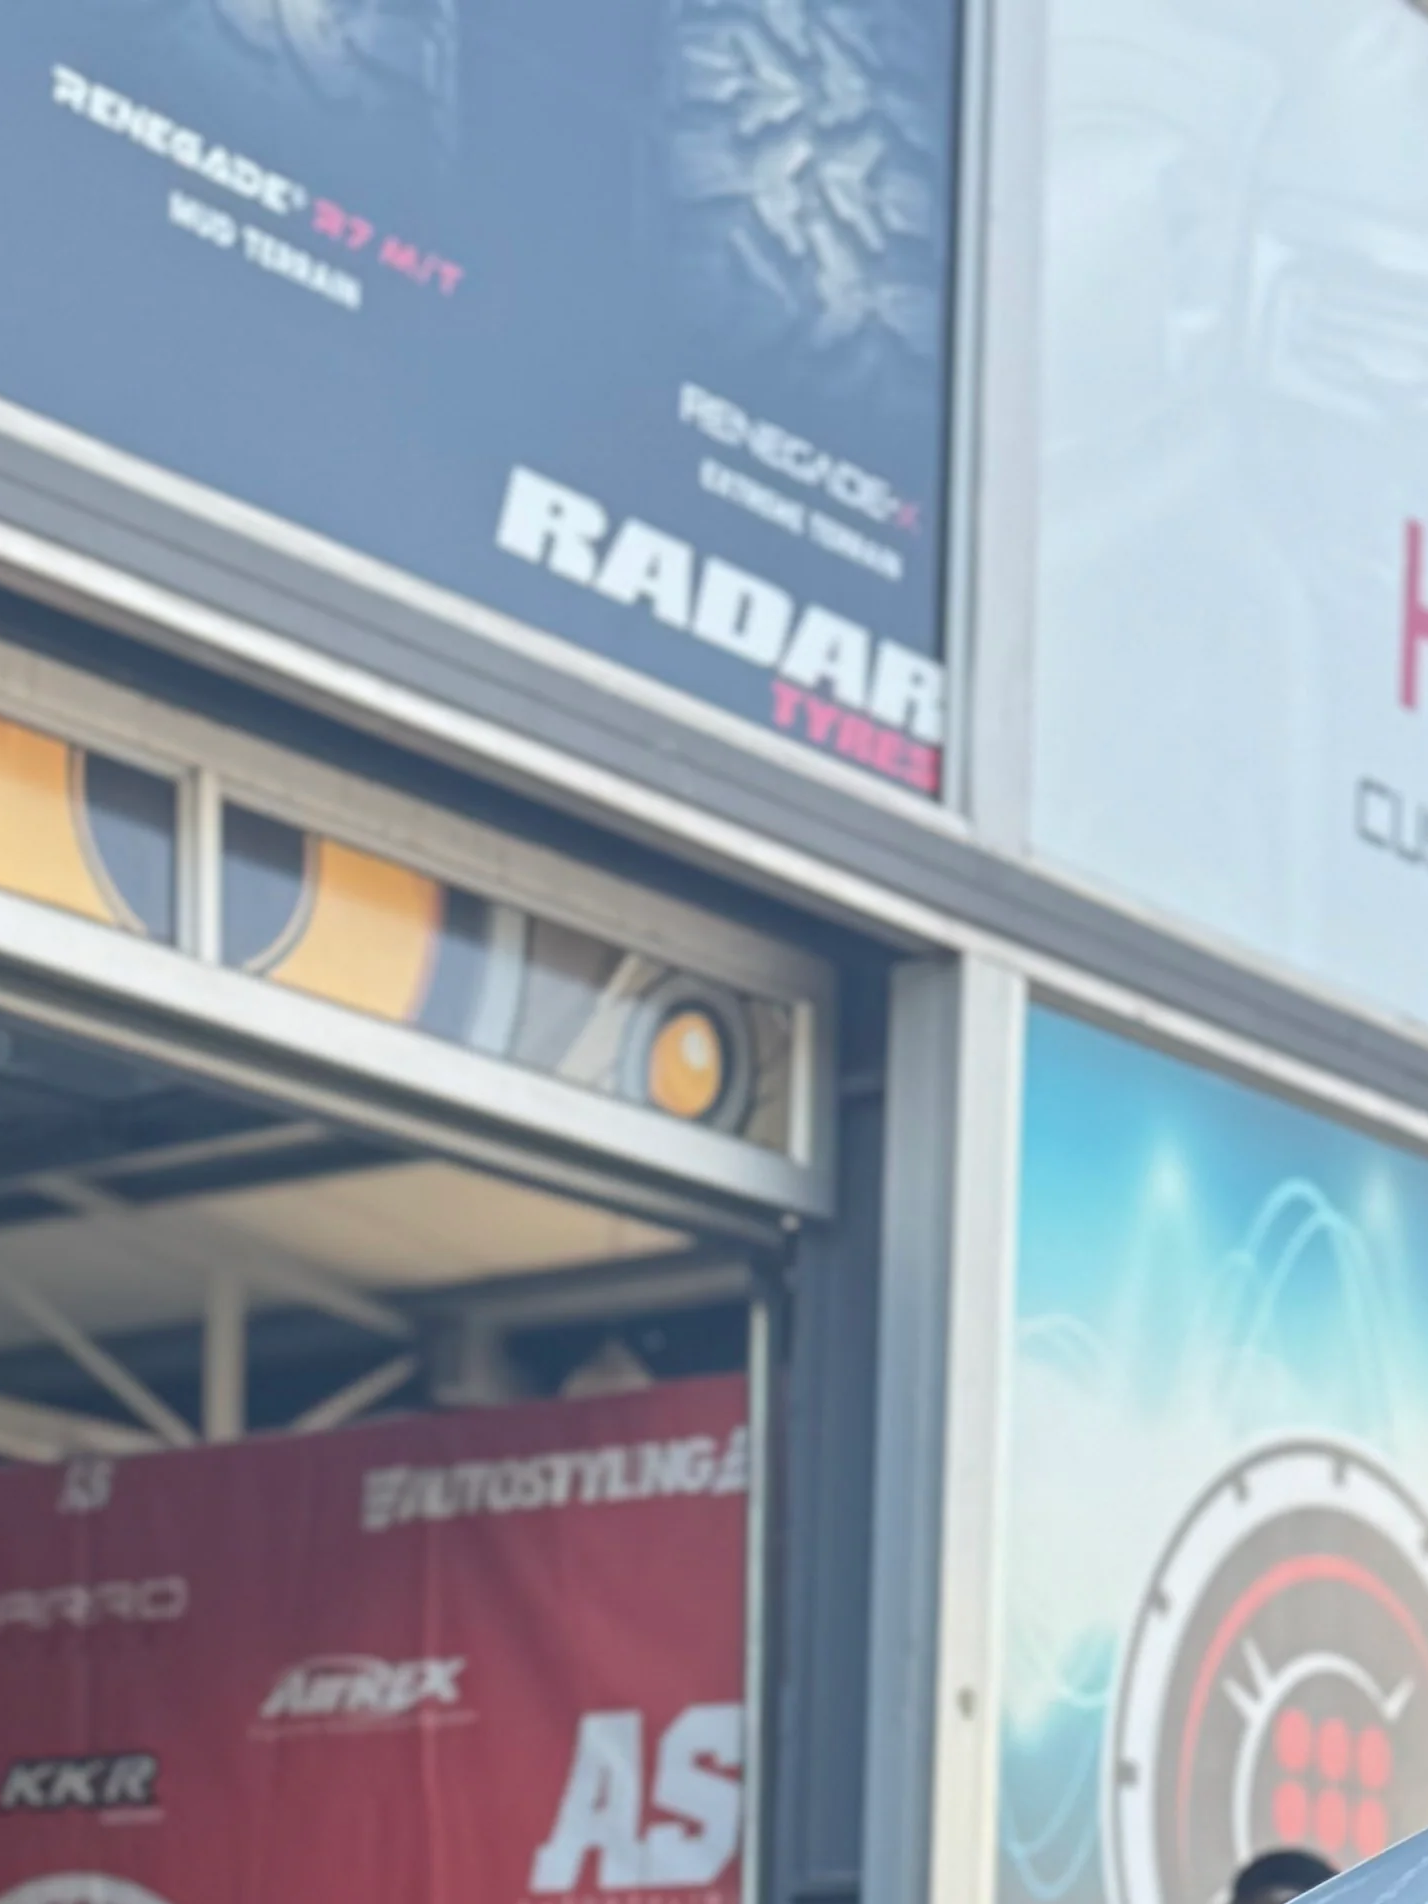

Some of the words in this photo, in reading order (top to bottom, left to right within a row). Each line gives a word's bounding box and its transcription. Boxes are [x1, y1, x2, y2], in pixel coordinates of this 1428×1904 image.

[495, 462, 946, 748] RADAR
[0, 1755, 158, 1811] KKR
[527, 1704, 744, 1894] AS
